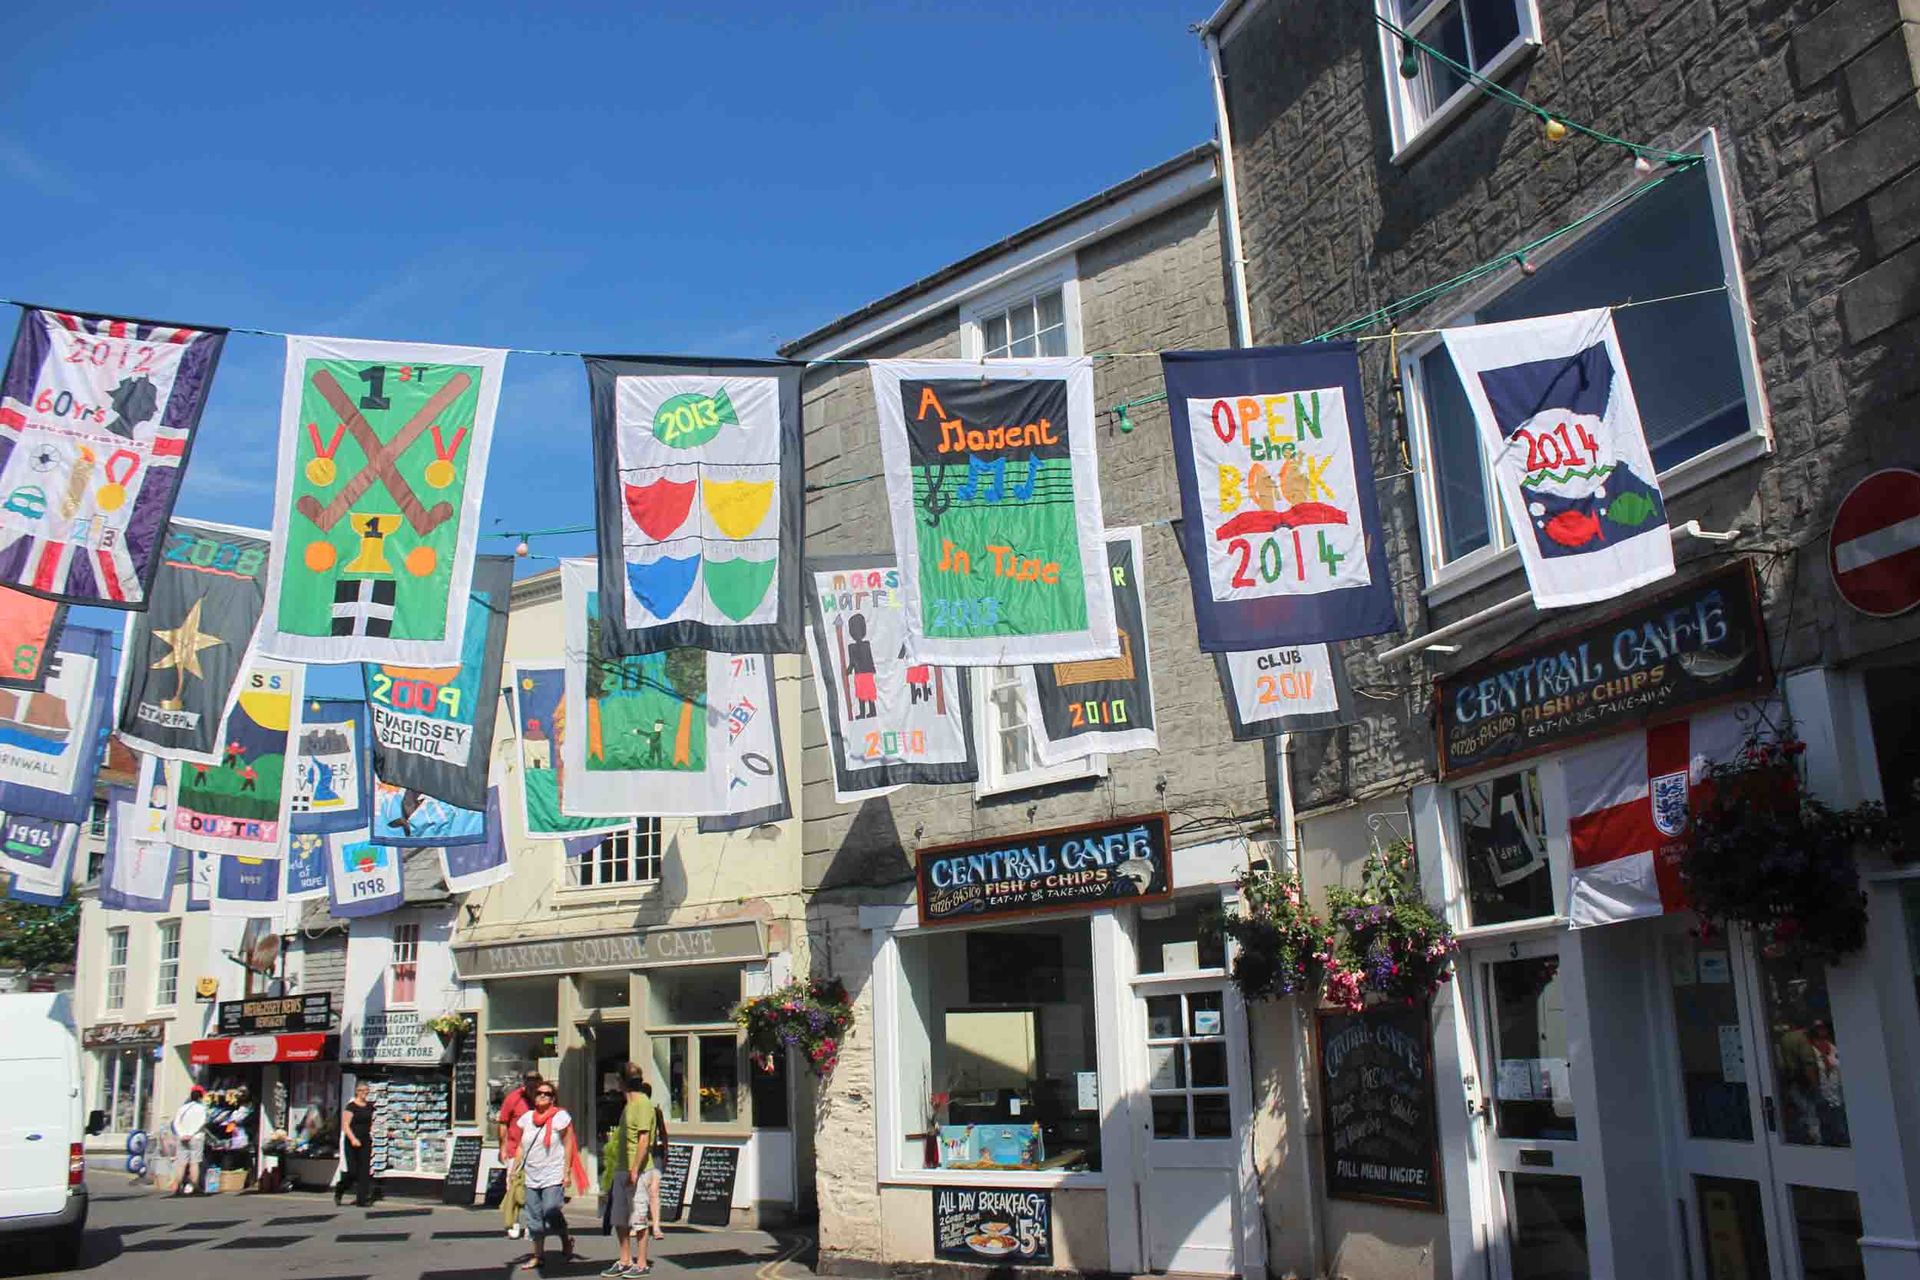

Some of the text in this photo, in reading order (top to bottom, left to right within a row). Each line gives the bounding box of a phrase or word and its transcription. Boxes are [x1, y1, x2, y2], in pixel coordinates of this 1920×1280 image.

[63, 337, 155, 374] 2012
[658, 399, 721, 442] 2013
[916, 386, 947, 421] A
[1211, 391, 1323, 446] OPEN
[938, 418, 1060, 454] Moment
[1249, 437, 1297, 461] the
[1511, 422, 1599, 473] 2014
[1217, 453, 1336, 515] BOOK
[363, 516, 383, 539] 1
[166, 534, 266, 577] 2008
[1228, 528, 1345, 589] 2014
[1257, 649, 1302, 671] CLUB
[373, 674, 460, 718] 2009
[1256, 671, 1312, 705] 2011
[1455, 642, 1602, 724] CENTRAL
[1592, 664, 1665, 701] CHIPS
[1068, 699, 1128, 729] 2010
[381, 729, 445, 756] SCHOOL
[864, 731, 925, 758] 2010
[8, 824, 52, 848] 1996
[177, 810, 275, 840] COUNTRY
[931, 844, 1056, 888] CENTRAL
[985, 880, 1025, 897] FISH
[1046, 868, 1108, 888] CHIPS
[352, 878, 387, 897] 1998
[488, 940, 565, 970] MARKET
[571, 931, 649, 966] SQUARE
[407, 1046, 434, 1057] STORE
[1337, 1160, 1358, 1178] FULL
[1360, 1162, 1387, 1181] MENU
[938, 1191, 957, 1215] ALL
[958, 1191, 977, 1212] DAY
